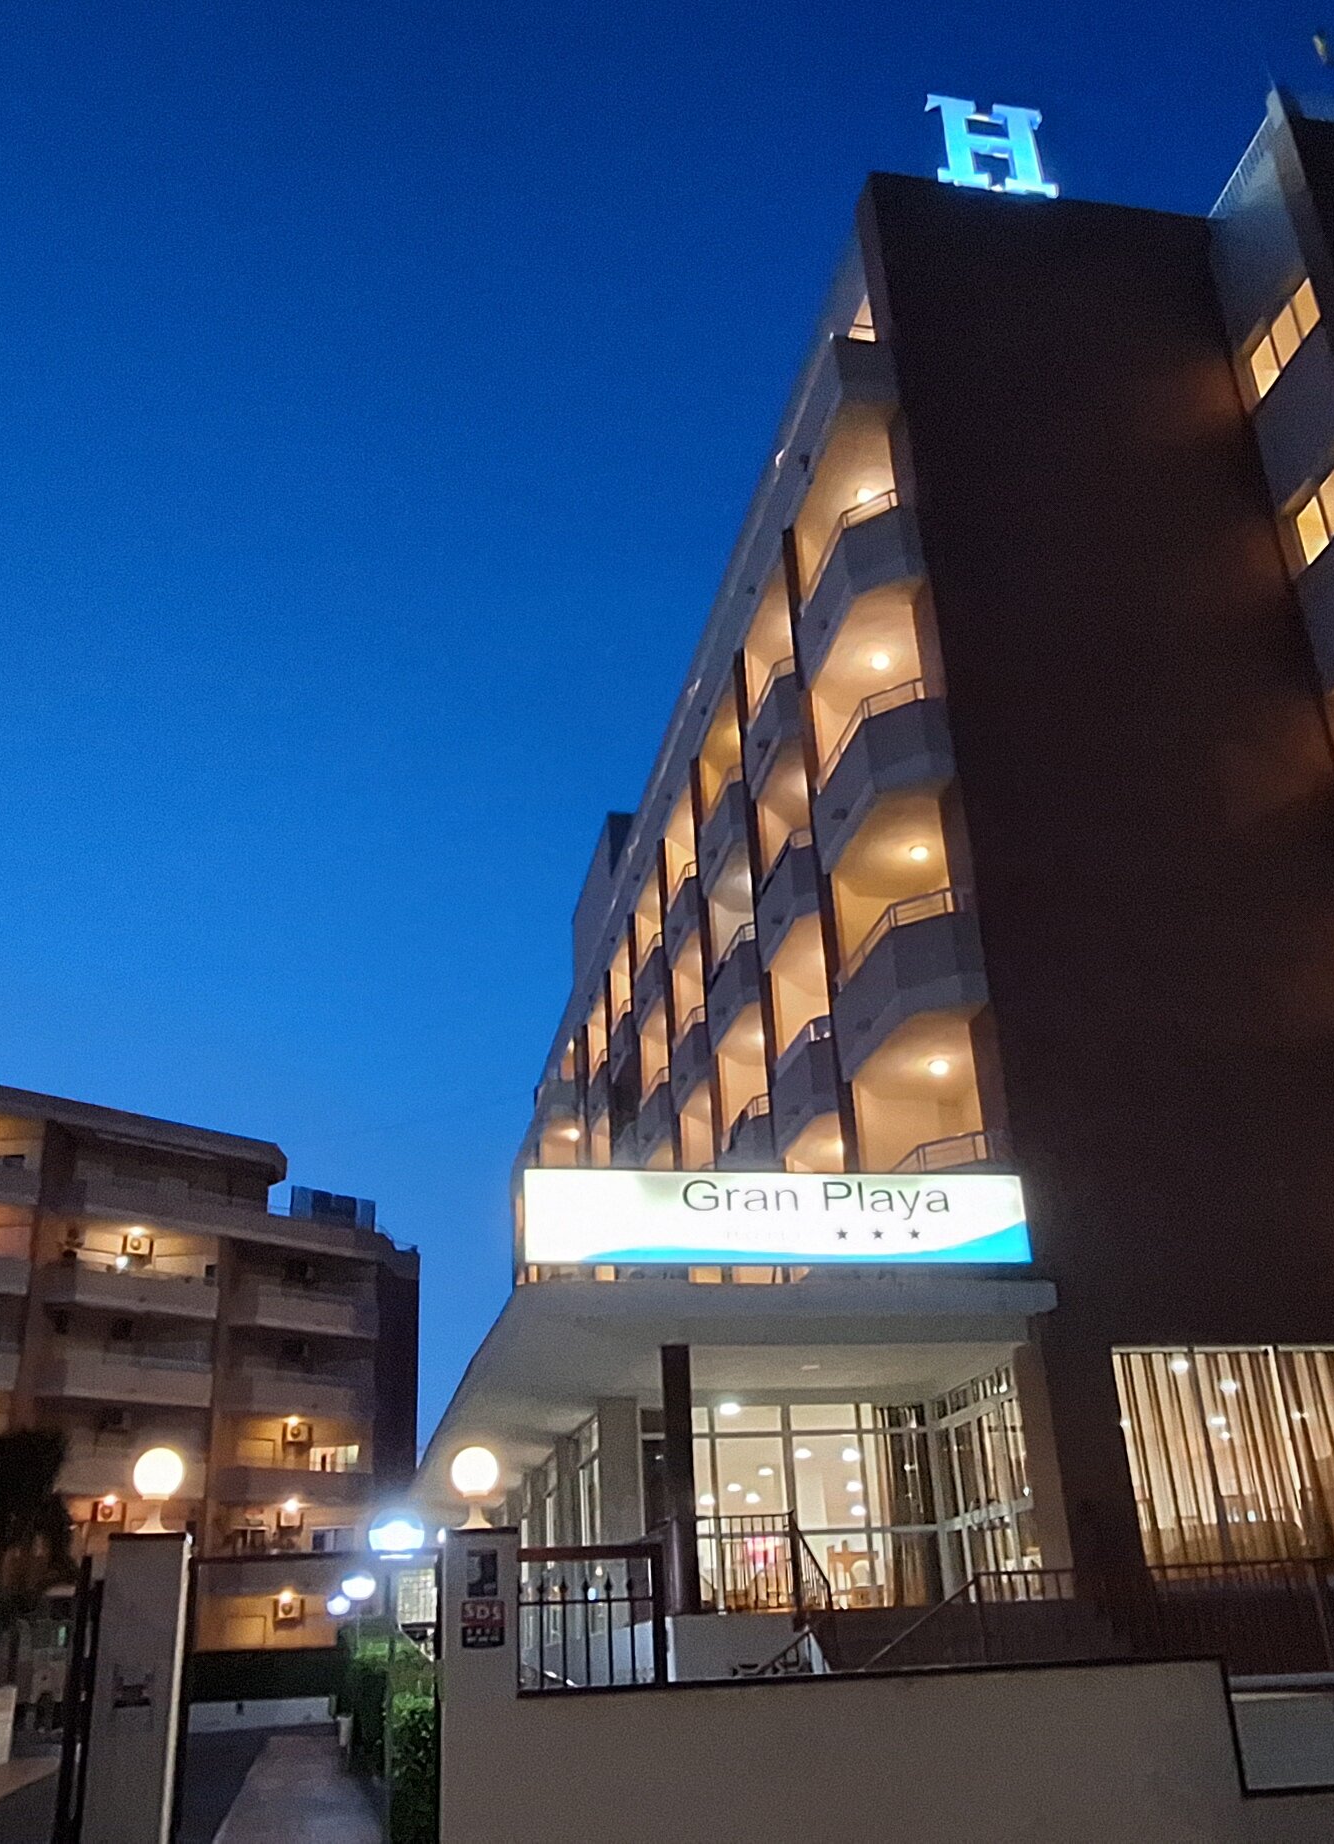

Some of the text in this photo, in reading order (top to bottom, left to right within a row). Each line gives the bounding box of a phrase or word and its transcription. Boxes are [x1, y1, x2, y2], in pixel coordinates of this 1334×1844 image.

[924, 94, 1060, 199] H
[681, 1179, 951, 1221] Gran Playa
